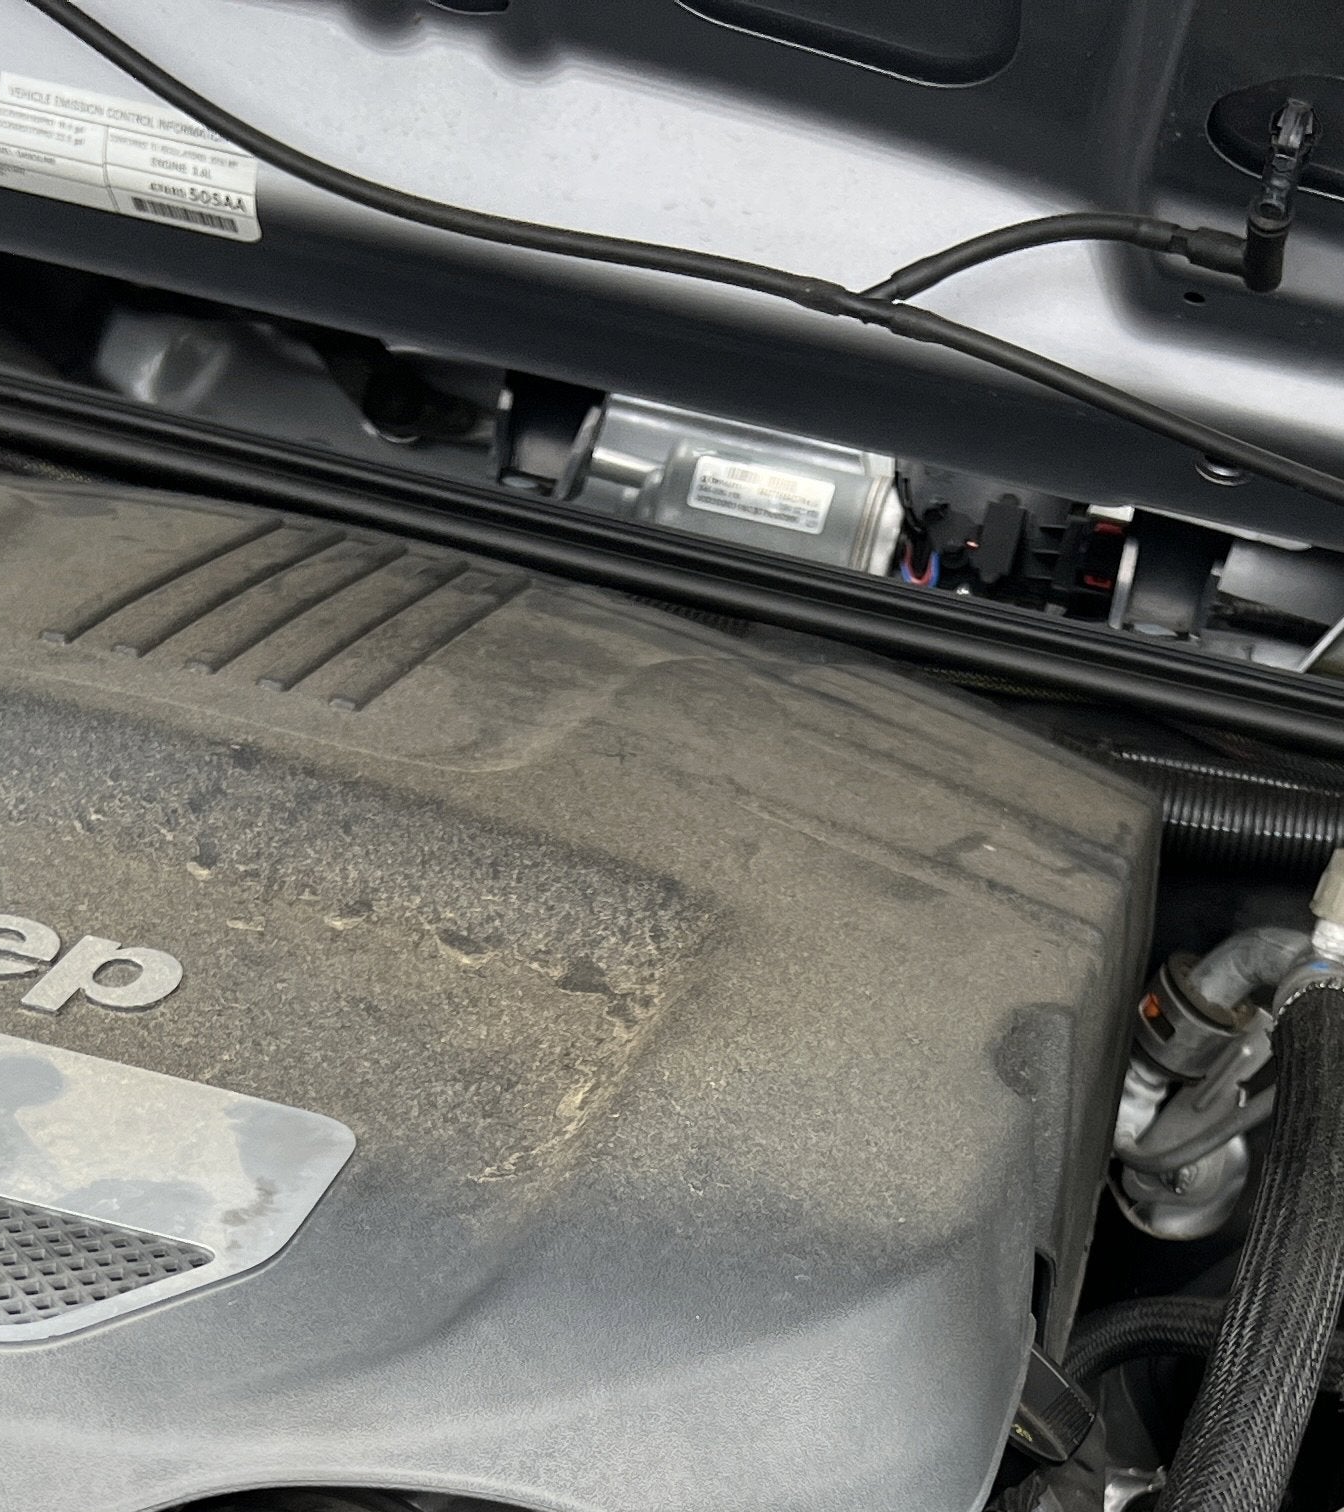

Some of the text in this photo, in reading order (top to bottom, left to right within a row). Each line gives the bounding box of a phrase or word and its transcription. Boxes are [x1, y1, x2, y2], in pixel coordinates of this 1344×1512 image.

[7, 85, 51, 105] VEHICLE
[54, 94, 104, 116] EMISSION
[106, 106, 155, 128] CONTROL
